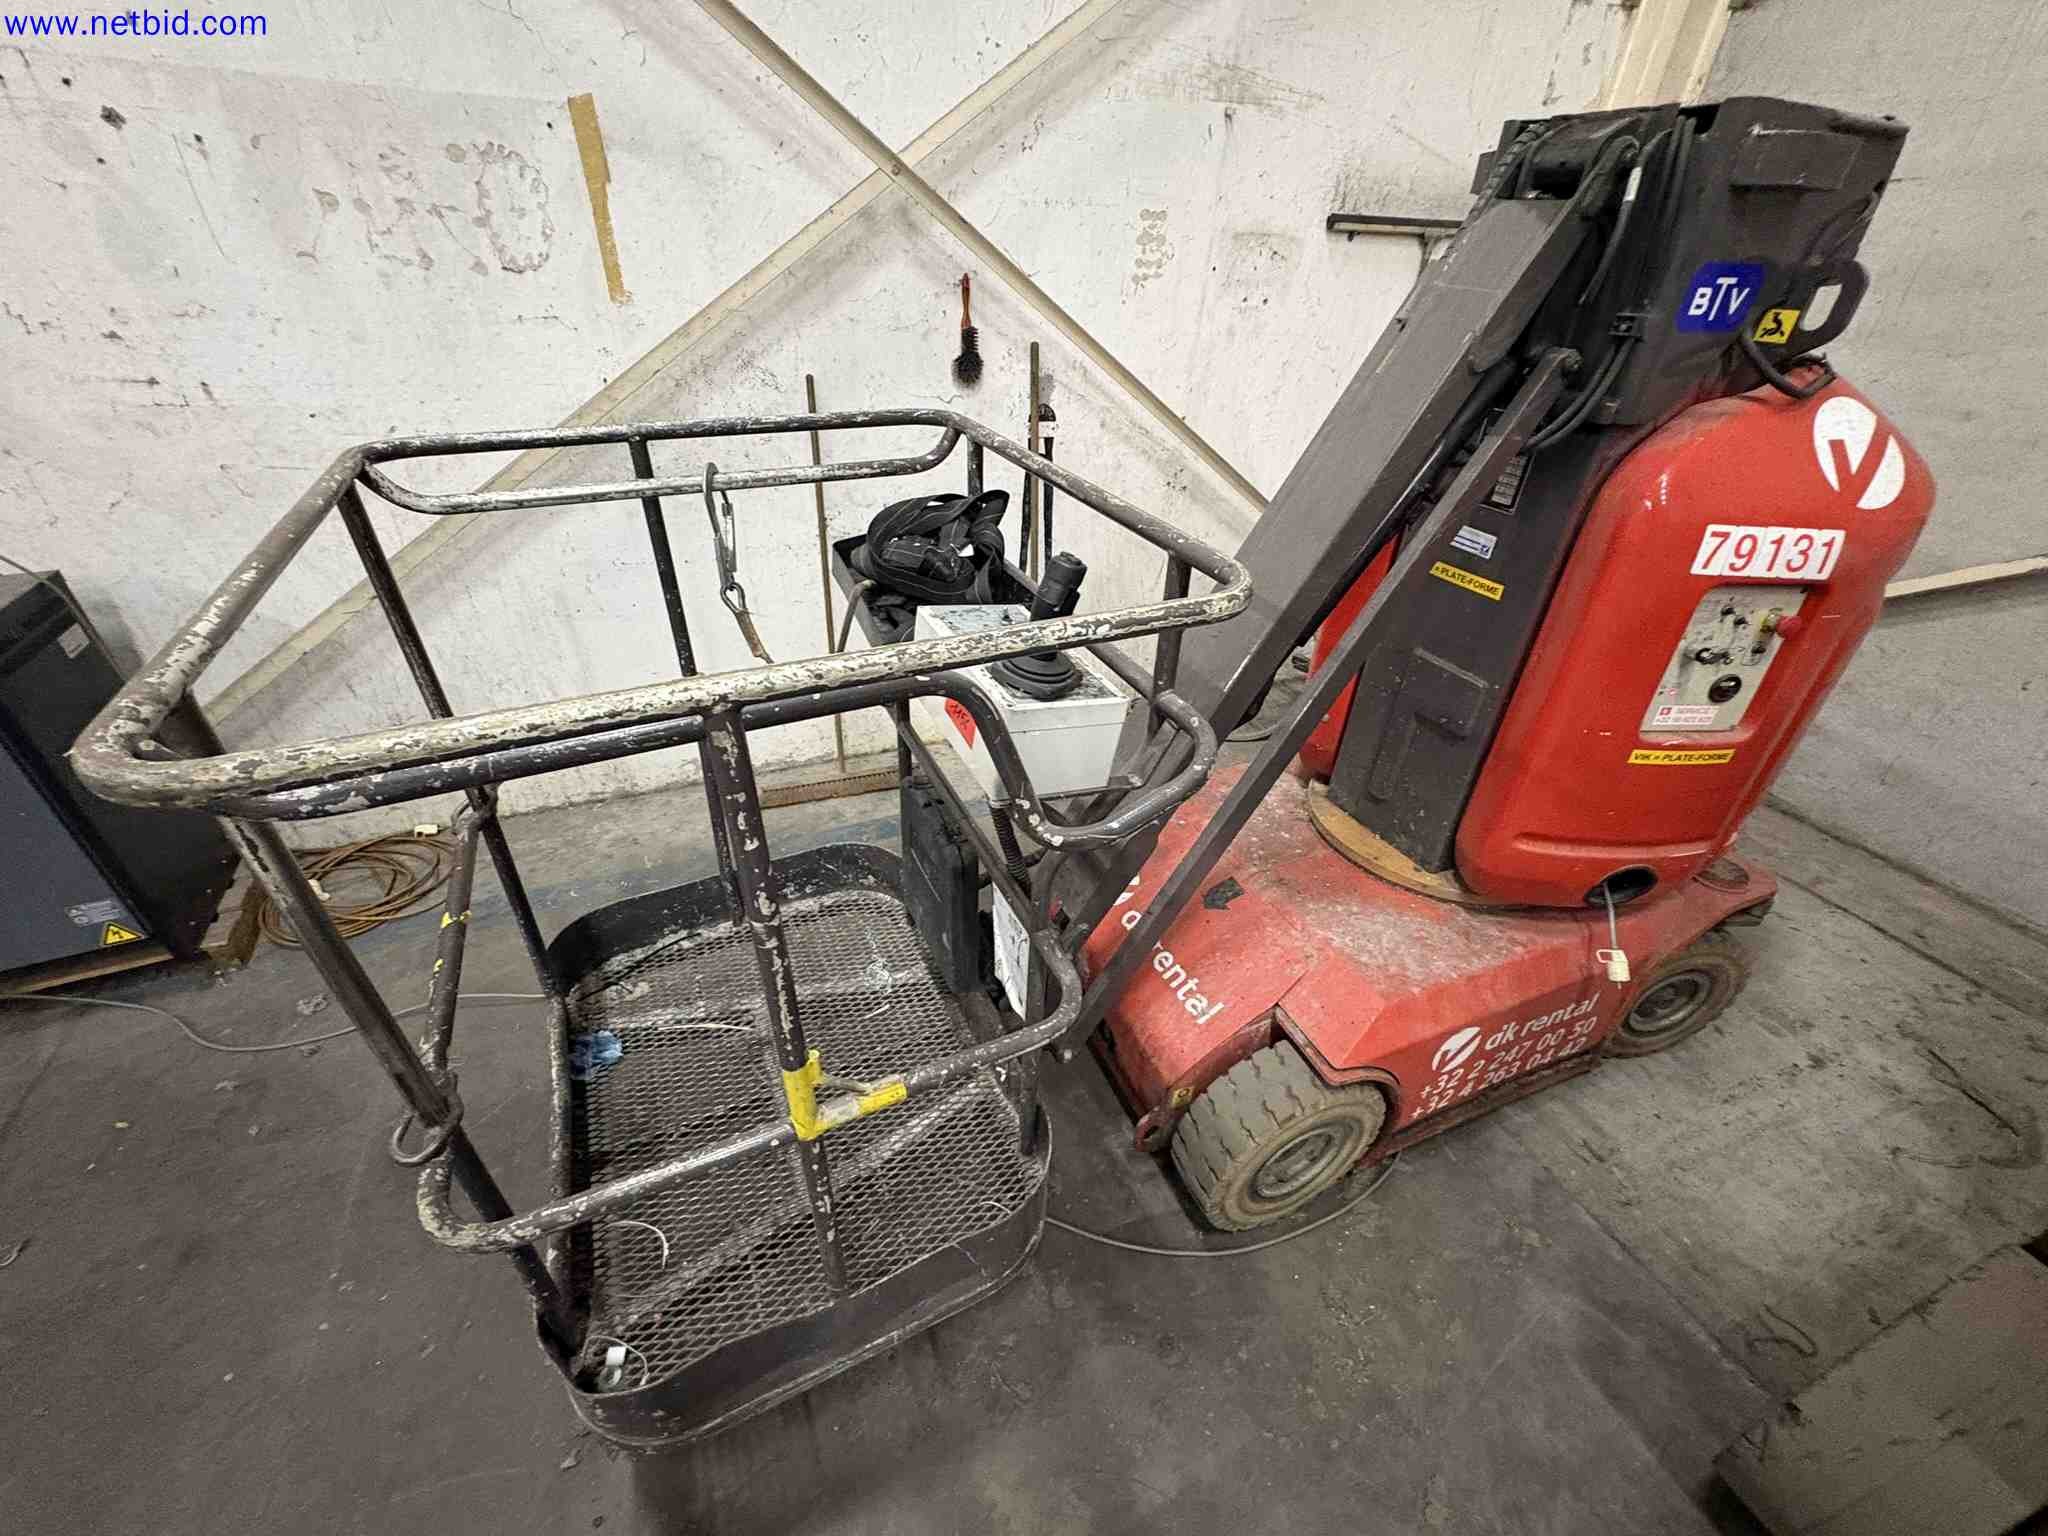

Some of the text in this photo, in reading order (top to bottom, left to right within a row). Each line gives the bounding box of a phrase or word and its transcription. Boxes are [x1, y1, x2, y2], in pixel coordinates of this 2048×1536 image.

[1687, 276, 1751, 321] BTV
[1702, 531, 1836, 574] 79131
[1486, 992, 1601, 1050] dk rental
[1420, 1016, 1598, 1100] +32 2 247 00 50
[1411, 1089, 1455, 1119] +32
